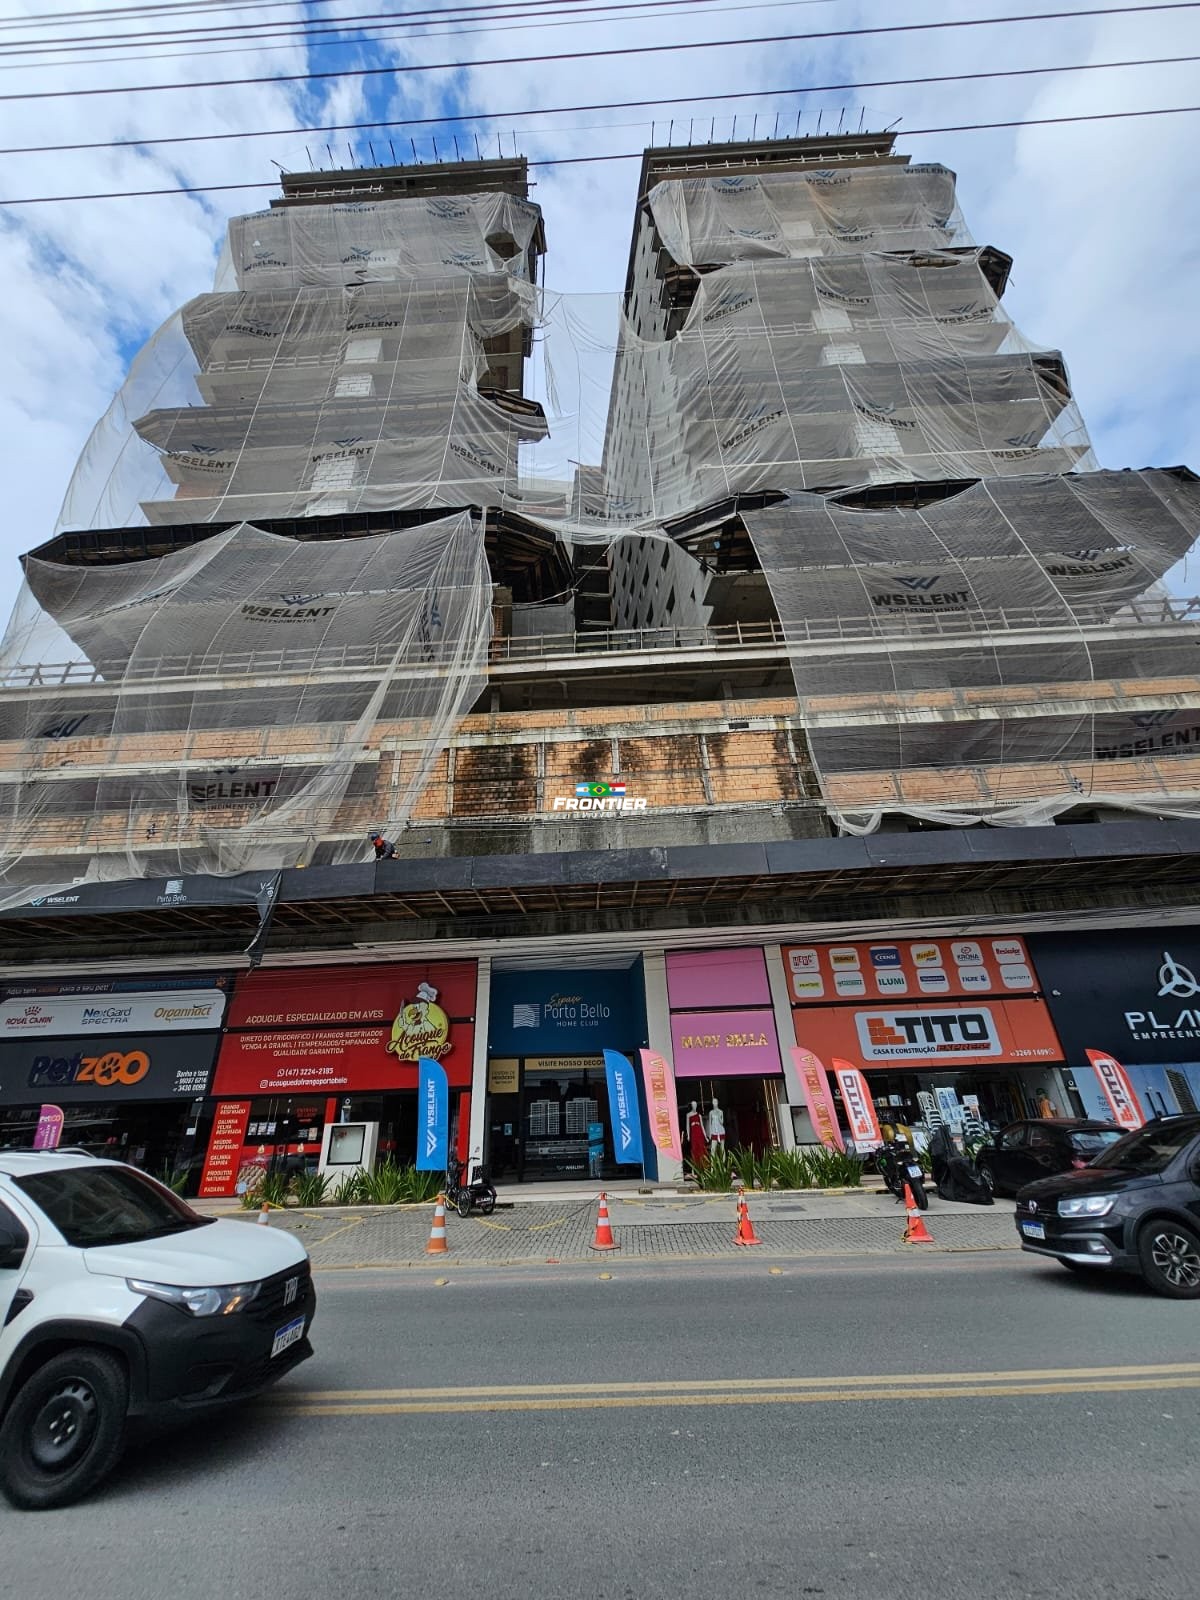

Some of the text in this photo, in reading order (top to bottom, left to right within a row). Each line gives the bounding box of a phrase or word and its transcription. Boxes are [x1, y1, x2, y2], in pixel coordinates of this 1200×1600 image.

[806, 177, 852, 186] WSELENT
[333, 206, 376, 214] WSELENT
[244, 259, 288, 272] WSELENT
[816, 286, 871, 303] WSELENT
[704, 298, 754, 322] WSELENT
[935, 306, 995, 324] WSELENT
[226, 324, 280, 338] WSELENT
[346, 321, 400, 331] WSELENT
[855, 403, 916, 428] WSELENT
[722, 410, 783, 449] WSELENT
[167, 453, 234, 469] WSELENT
[312, 447, 373, 463] WSELENT
[450, 442, 504, 474] WSELENT
[1045, 556, 1133, 576] WSELENT
[871, 591, 969, 606] WSELENT
[241, 604, 336, 618] WSELENT
[47, 895, 80, 904] WSELENT
[878, 978, 904, 986] ILUMI
[83, 1007, 132, 1017] NexGard
[154, 1006, 212, 1023] Organnact
[246, 1010, 384, 1024] AÇOUGUE ESPECIALIZADO EM AVES
[544, 1003, 610, 1019] Porto Bello
[6, 1017, 28, 1025] ROYAL
[894, 1013, 989, 1044] TITO
[345, 1030, 383, 1038] RESFRIADOS
[681, 1034, 720, 1048] MARY
[896, 1046, 936, 1054] CONSTRUÇÃO
[1099, 1065, 1126, 1107] TITO
[427, 1078, 436, 1127] WSELENT
[615, 1071, 627, 1119] WSELENT
[650, 1057, 674, 1149] MARY BELLA
[843, 1075, 862, 1119] TITO
[814, 1101, 833, 1142] MARY
